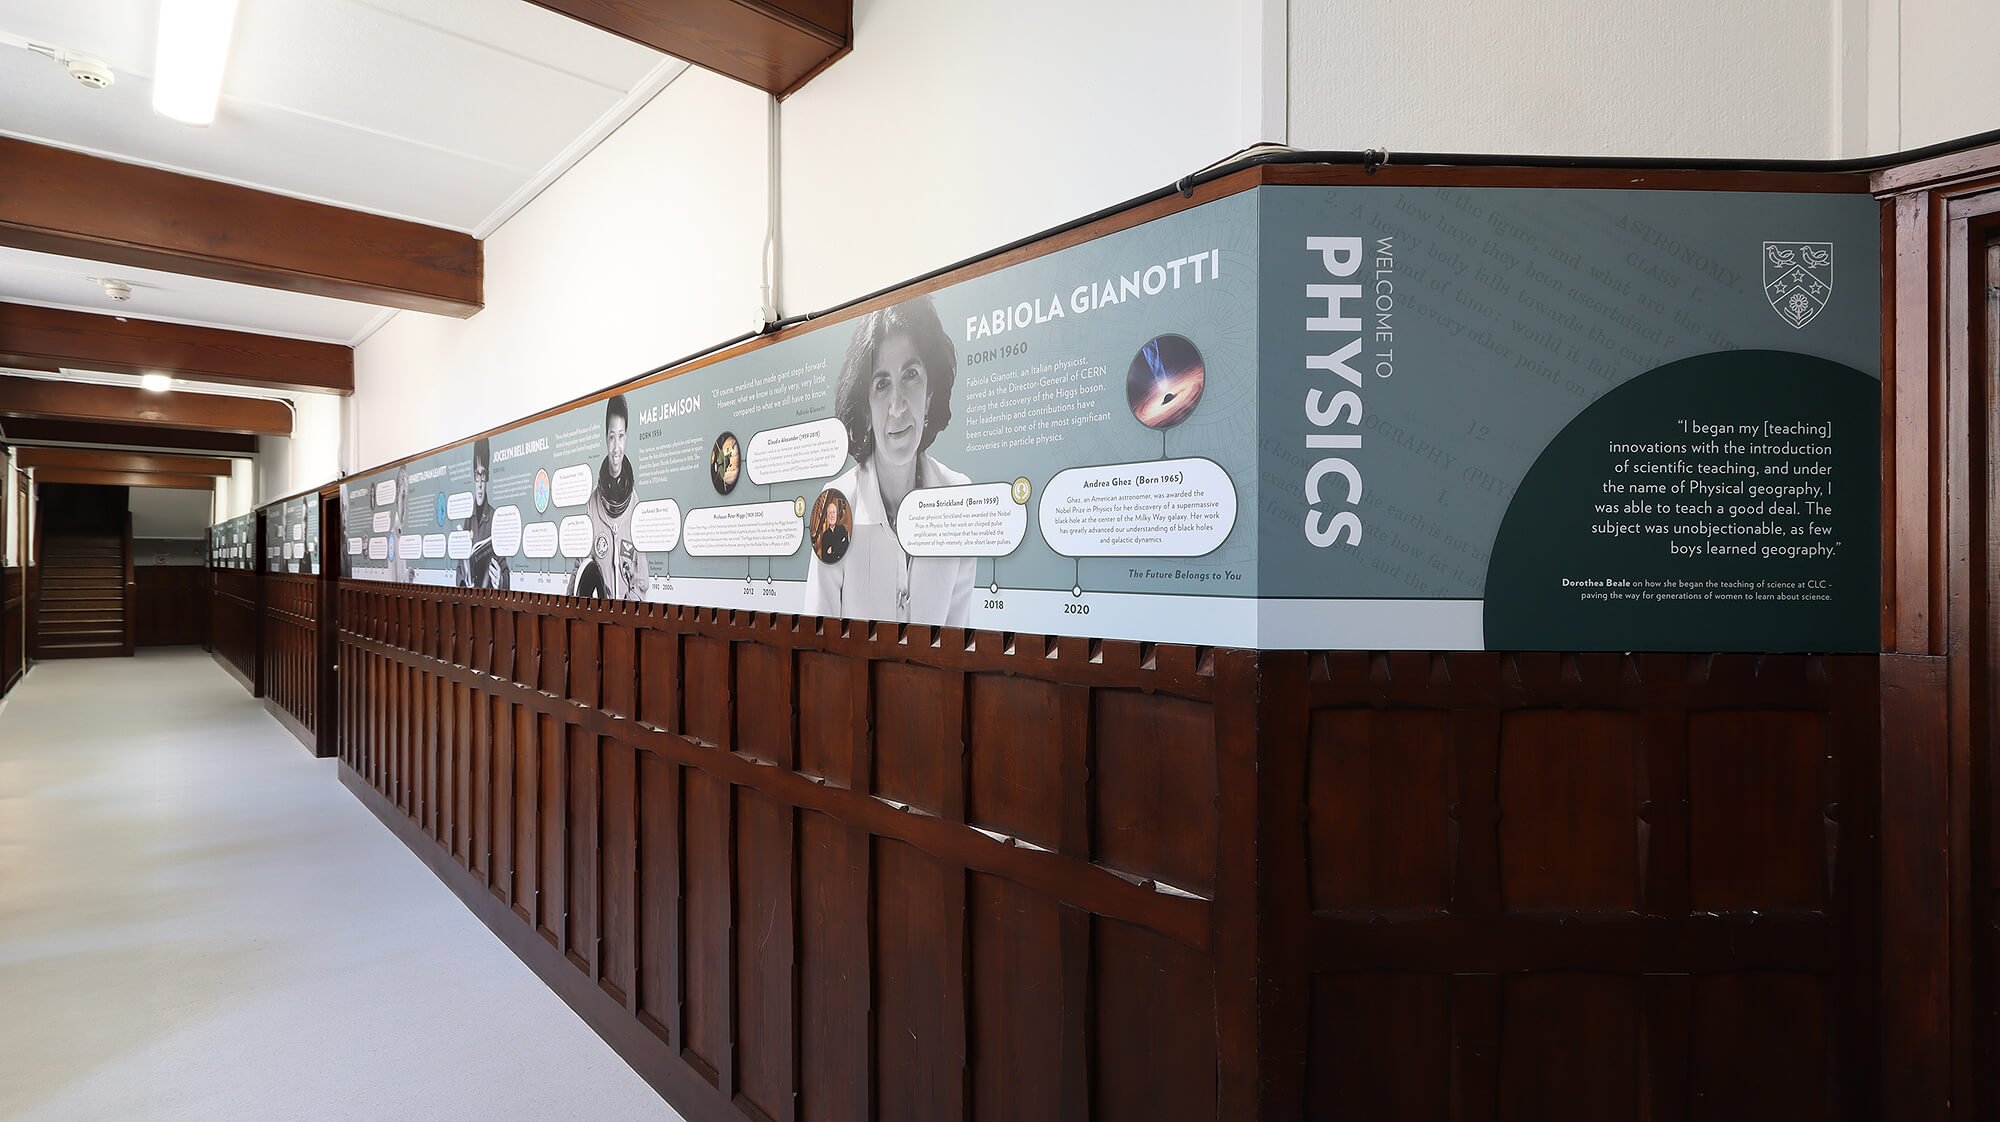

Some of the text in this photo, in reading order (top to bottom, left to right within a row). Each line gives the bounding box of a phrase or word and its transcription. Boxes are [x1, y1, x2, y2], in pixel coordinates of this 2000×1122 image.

[966, 248, 1219, 341] FABIOLA GIANOTTI
[1376, 236, 1394, 378] WELCOME TO
[967, 342, 1028, 366] BORN 1960
[966, 388, 986, 400] served
[997, 386, 1007, 395] the
[1009, 373, 1068, 393] Director-General
[1070, 370, 1079, 381] of
[1081, 365, 1106, 379] CERN
[967, 375, 989, 387] Fabiola
[1031, 364, 1052, 374] Italian
[966, 384, 1106, 413] during the discovery of the Higgs boson.
[1305, 236, 1362, 548] PHYSICS
[640, 394, 700, 425] MAE JEMISON
[966, 399, 1095, 426] Her leadership and contributions have
[966, 430, 982, 439] been
[983, 425, 1004, 437] crucial
[1028, 420, 1036, 430] of
[1038, 419, 1049, 429] the
[1051, 418, 1069, 427] most
[1072, 412, 1111, 426] significant
[1678, 420, 1831, 438] “I began my [teaching]
[966, 441, 1000, 452] discoveries
[1009, 435, 1035, 448] particle
[1036, 433, 1064, 446] physics.
[1610, 440, 1832, 455] innovations with the introduction
[1615, 459, 1832, 478] of scientific teaching, and under
[1083, 471, 1183, 488] Andrea Ghez (Born 1965)
[1603, 480, 1831, 498] the name of Physical geography, I
[936, 499, 964, 508] Strickland
[966, 498, 982, 507] (Born
[984, 496, 999, 506] 1959)
[1595, 500, 1832, 518] was able to teach a good deal. The
[1592, 520, 1832, 538] subject was unobjectionable, as few
[1671, 540, 1841, 559] boys learned geography.”
[1129, 569, 1144, 578] The
[1146, 569, 1172, 579] Future
[1175, 570, 1210, 582] Belongs
[1225, 571, 1242, 580] You
[1562, 578, 1604, 587] Dorothea
[1606, 578, 1631, 587] Beale
[1645, 579, 1662, 587] how
[1664, 579, 1677, 587] she
[1679, 579, 1704, 590] began
[1706, 580, 1718, 588] the
[1721, 580, 1754, 590] teaching
[1756, 580, 1765, 588] of
[1808, 580, 1826, 588] CLC
[984, 600, 1004, 610] 2018
[1581, 592, 1608, 601] paving
[1610, 591, 1623, 599] the
[1642, 591, 1654, 599] for
[1656, 592, 1702, 602] generations
[1704, 591, 1713, 600] of
[1756, 592, 1775, 600] learn
[1777, 592, 1799, 600] about
[1064, 604, 1090, 615] 2020
